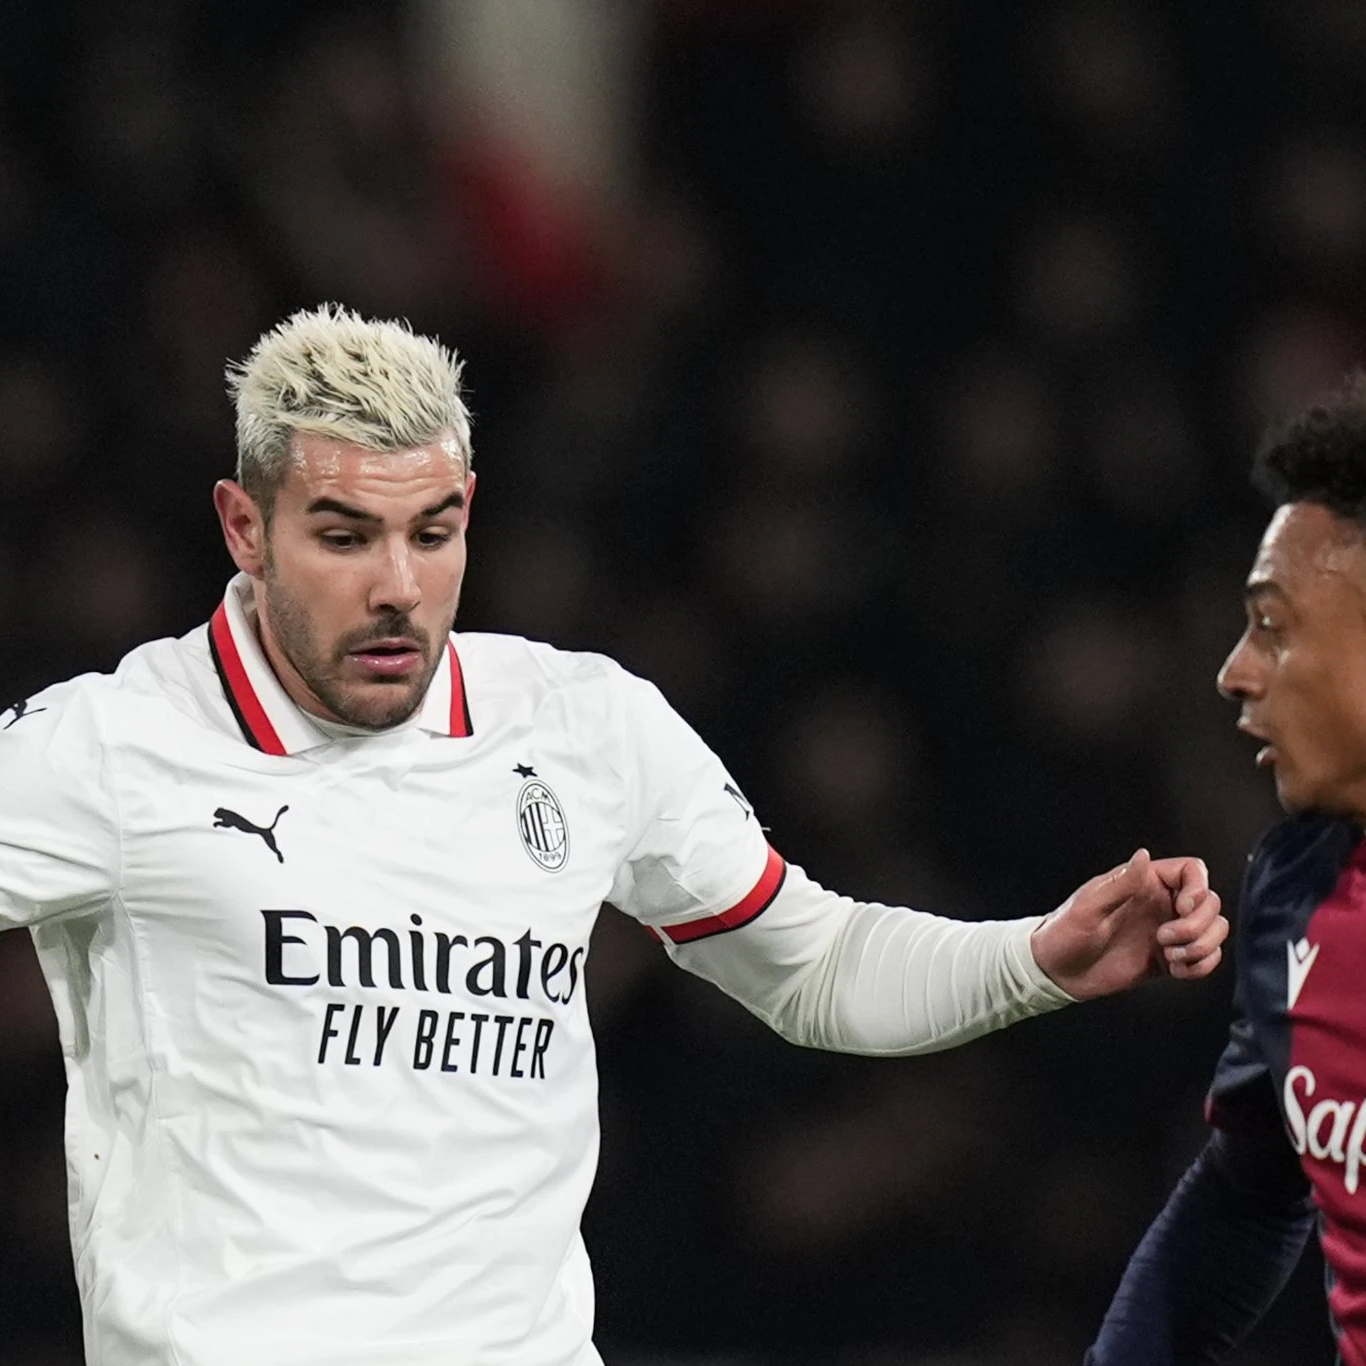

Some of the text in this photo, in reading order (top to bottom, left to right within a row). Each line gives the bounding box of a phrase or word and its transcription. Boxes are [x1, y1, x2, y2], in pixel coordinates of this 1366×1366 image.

[260, 910, 584, 1005] Emirates
[317, 1003, 554, 1079] FLY BETTER
